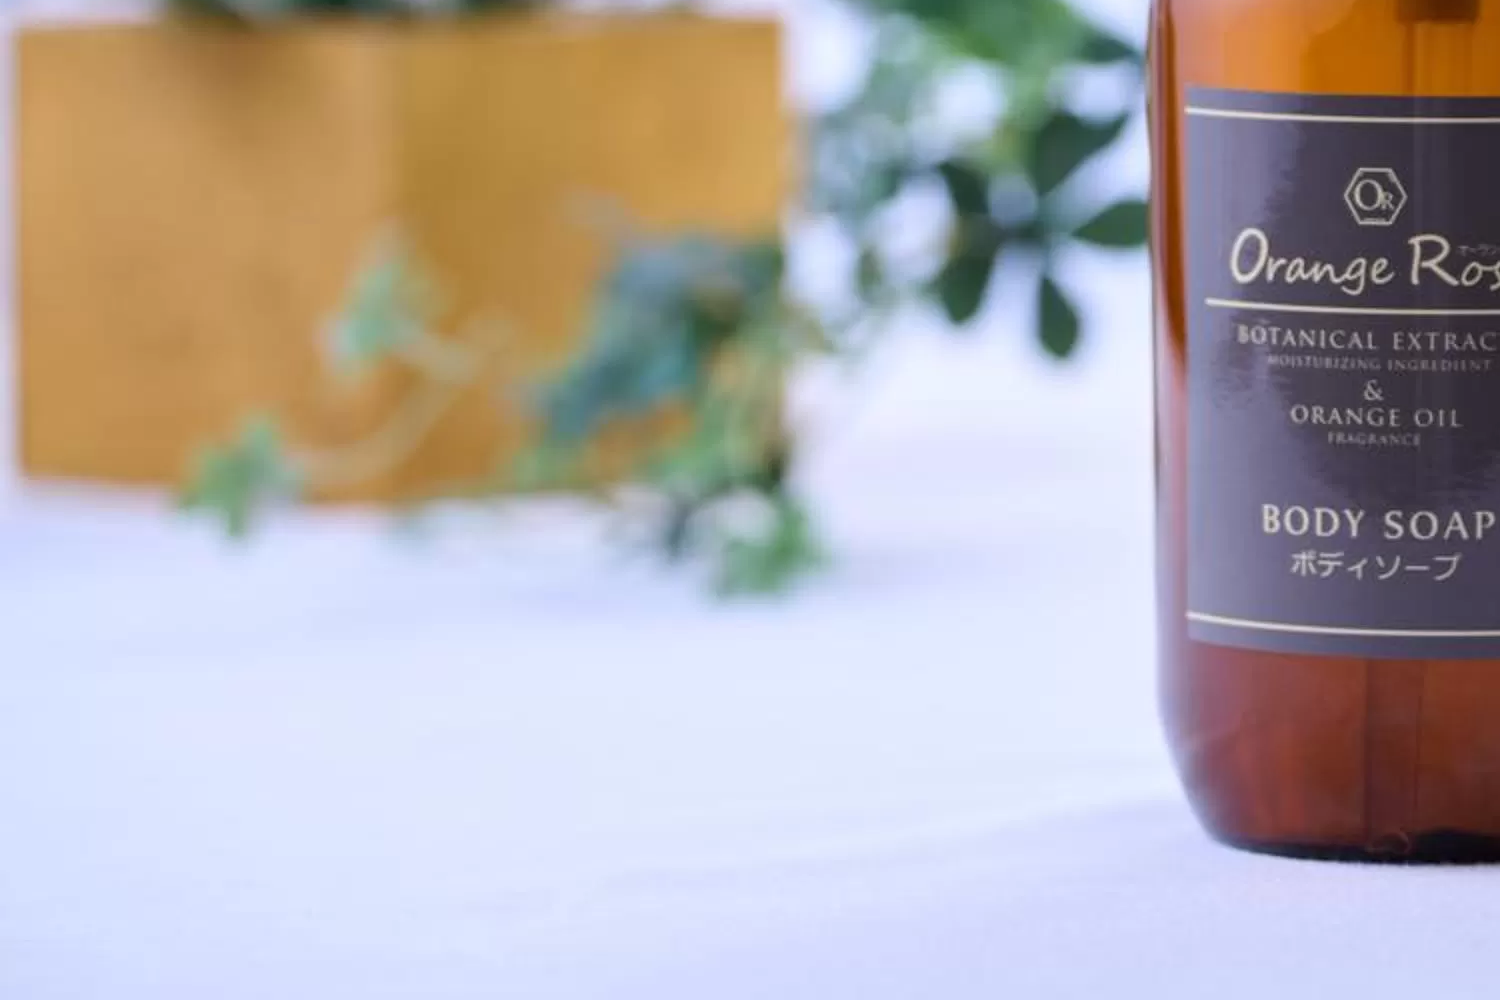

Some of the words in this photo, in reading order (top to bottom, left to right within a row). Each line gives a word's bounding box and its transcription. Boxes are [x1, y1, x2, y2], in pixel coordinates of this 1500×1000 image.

[1229, 227, 1395, 296] Orange
[1237, 323, 1378, 352] BOTANICAL
[1267, 354, 1382, 371] MOISTURIZING
[1386, 358, 1492, 373] INGREDIENT
[1363, 379, 1385, 402] &
[1290, 404, 1402, 428] ORANGE
[1414, 408, 1464, 428] OIL
[1327, 431, 1421, 447] FRAGRANCE
[1261, 503, 1365, 539] BODY
[1383, 509, 1497, 541] SOAP
[1290, 551, 1463, 581] ボディソープ
